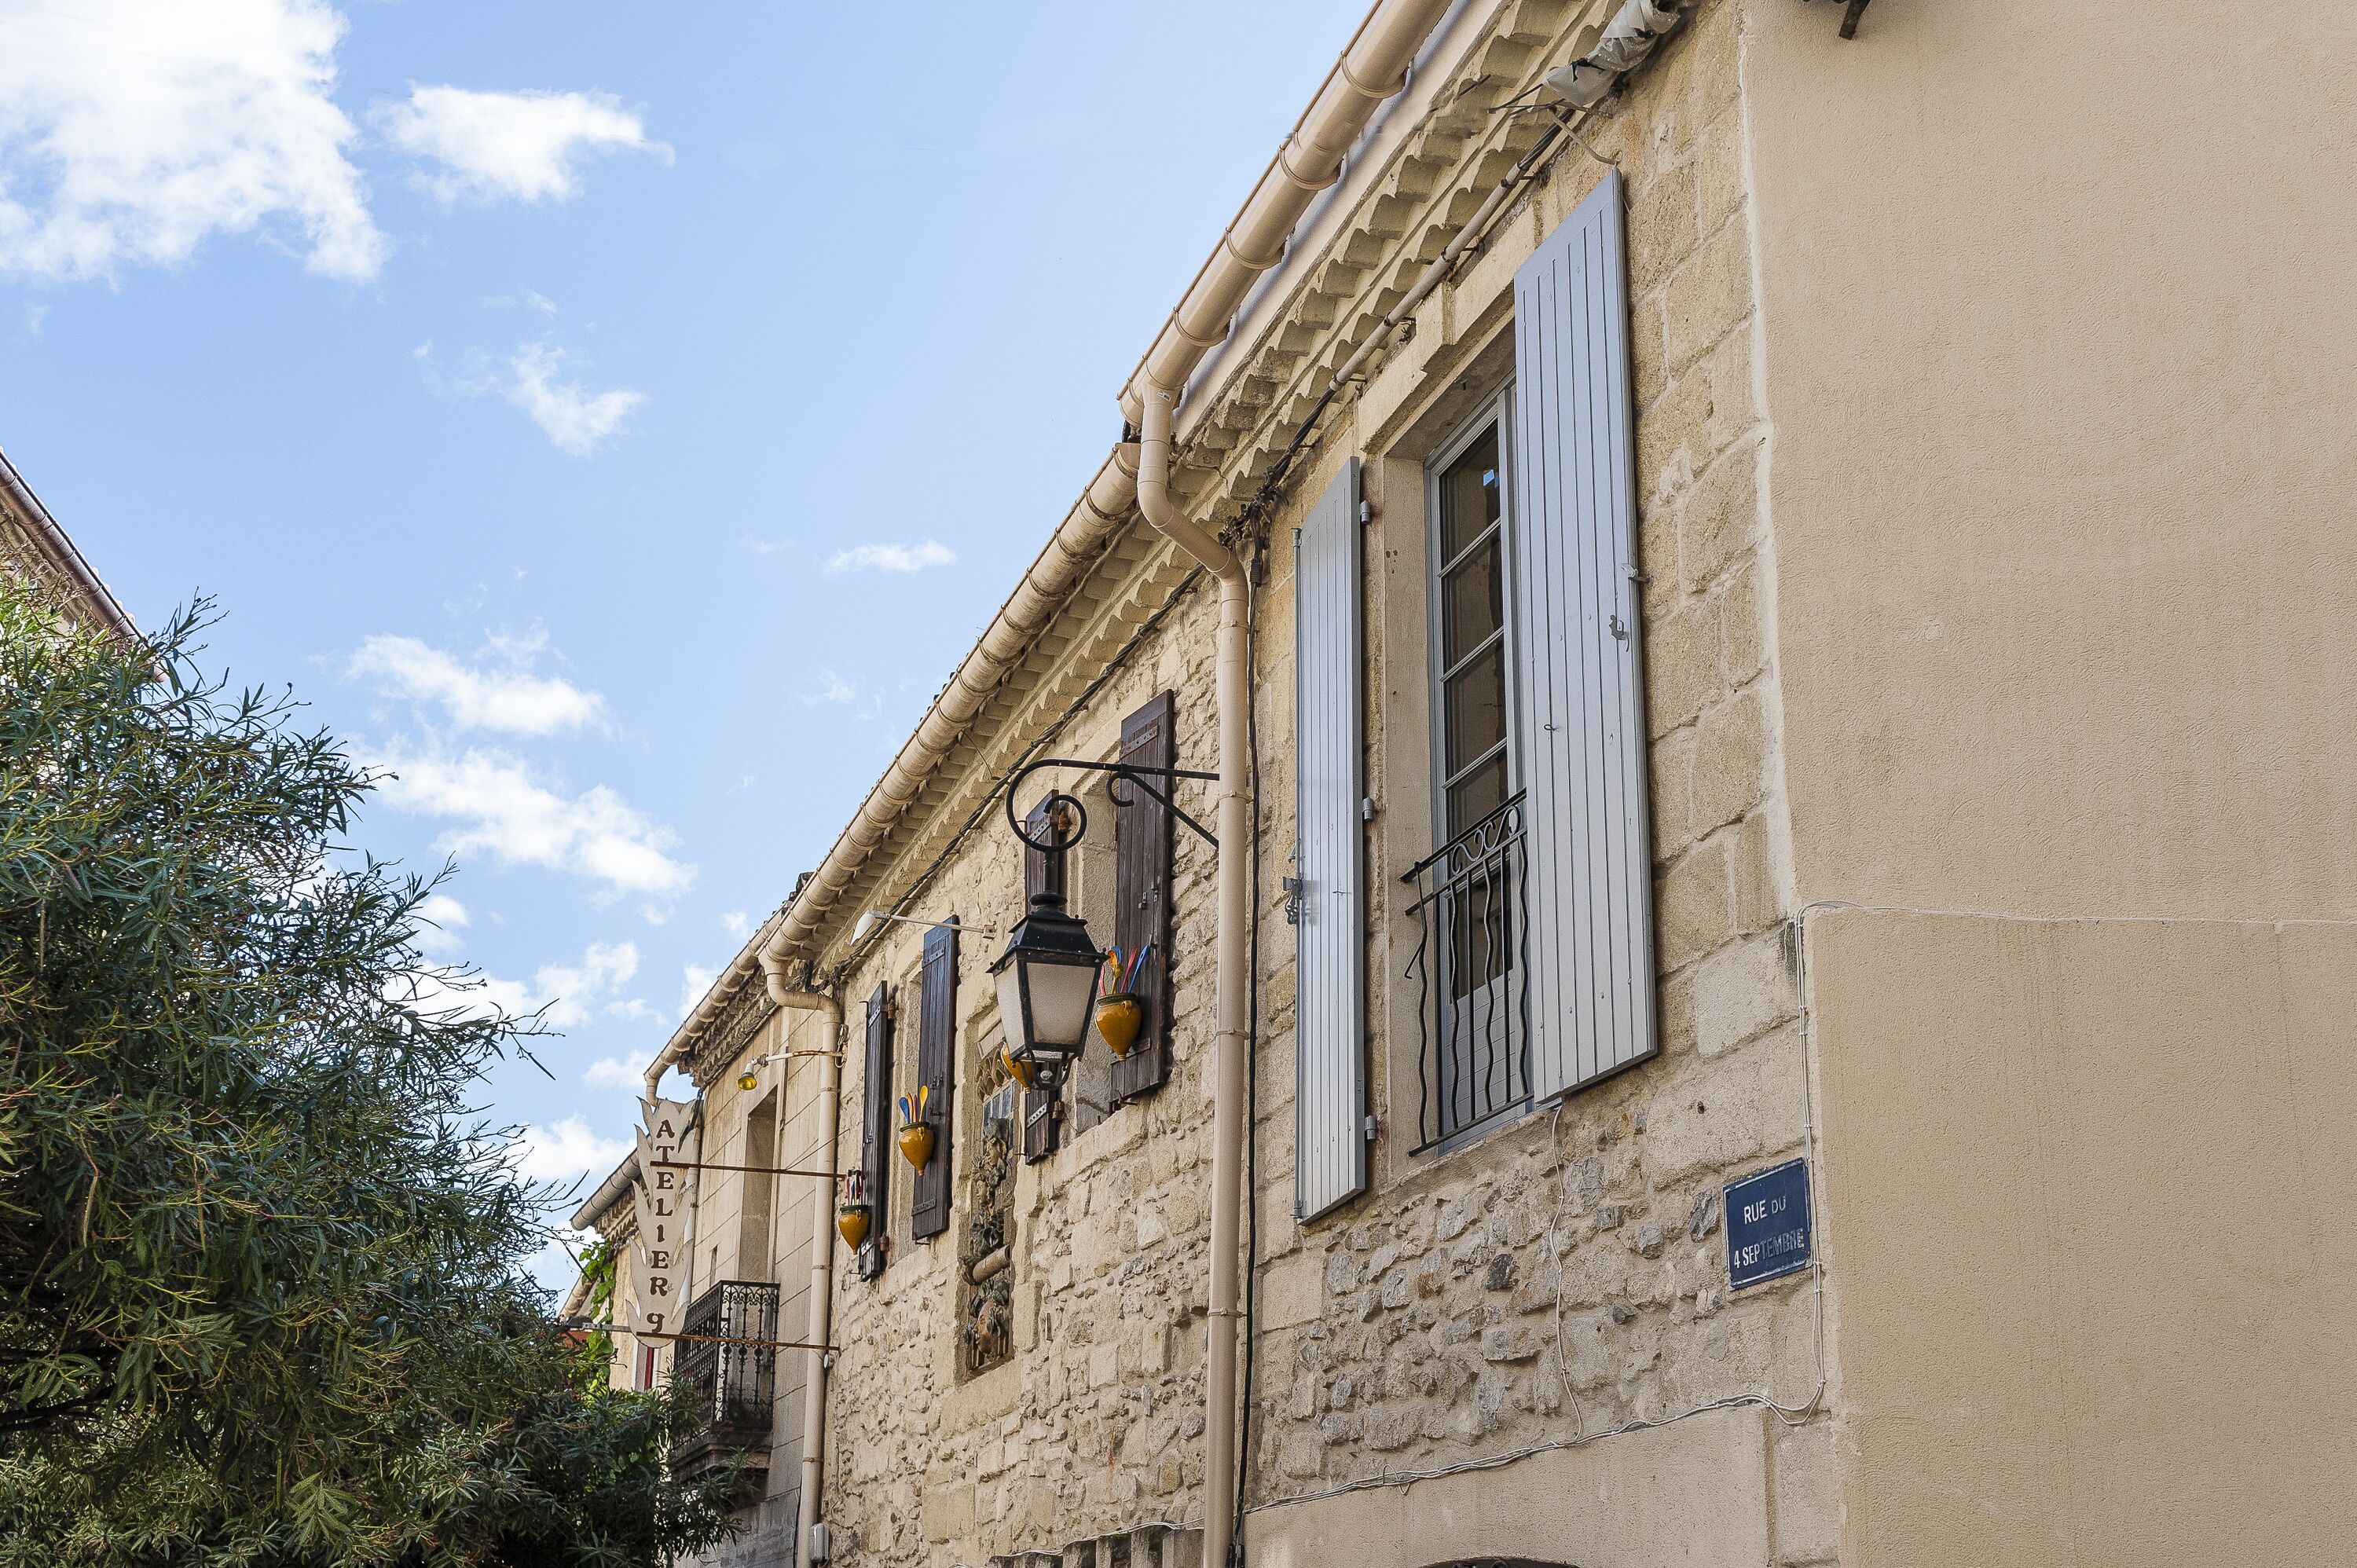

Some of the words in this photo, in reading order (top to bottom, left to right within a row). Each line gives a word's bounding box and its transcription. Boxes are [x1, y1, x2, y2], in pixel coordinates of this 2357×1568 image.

[649, 1119, 676, 1297] ATELIER
[1743, 1199, 1768, 1225] RUE
[1771, 1196, 1787, 1215] DU
[1733, 1249, 1741, 1269] 4
[1742, 1227, 1805, 1267] SEPTEMBRE
